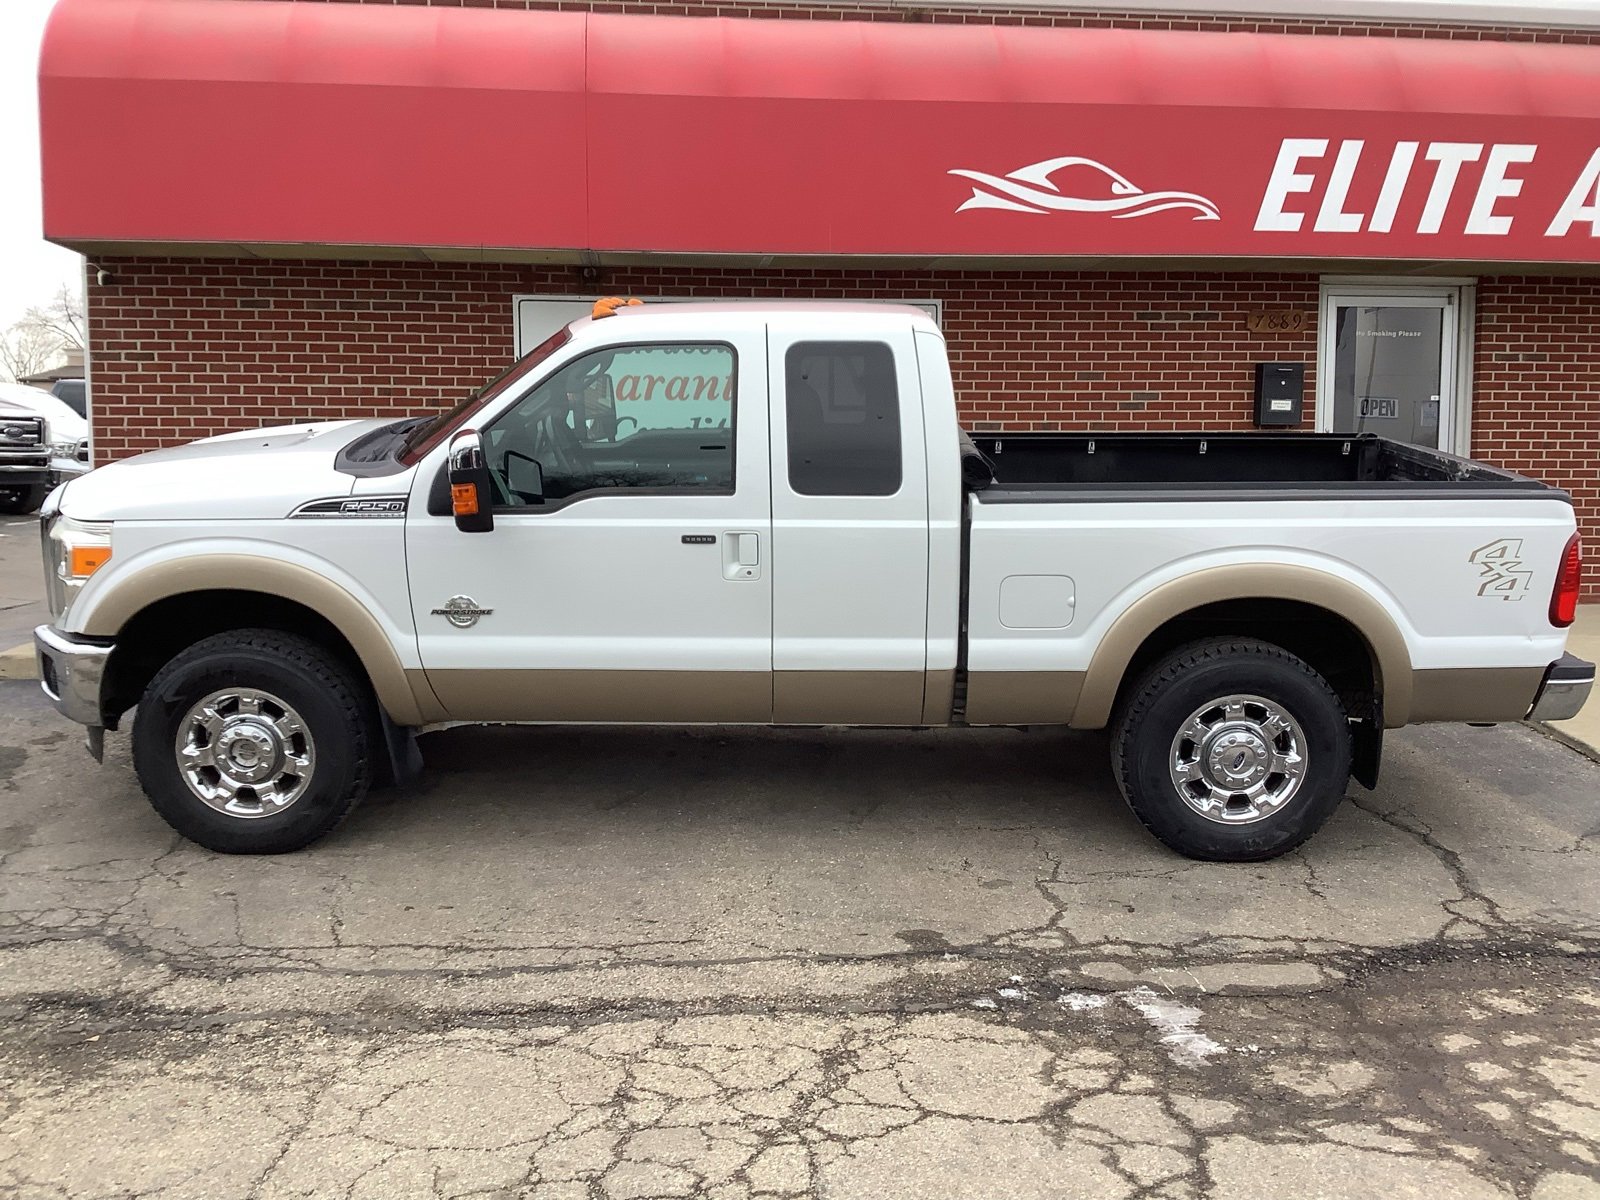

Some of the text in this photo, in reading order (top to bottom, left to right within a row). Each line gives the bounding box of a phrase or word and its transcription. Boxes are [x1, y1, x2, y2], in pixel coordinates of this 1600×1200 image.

[1253, 138, 1538, 235] ELITE
[1254, 313, 1302, 330] 7889
[1367, 330, 1397, 338] Smoking
[1360, 399, 1396, 417] OPEN
